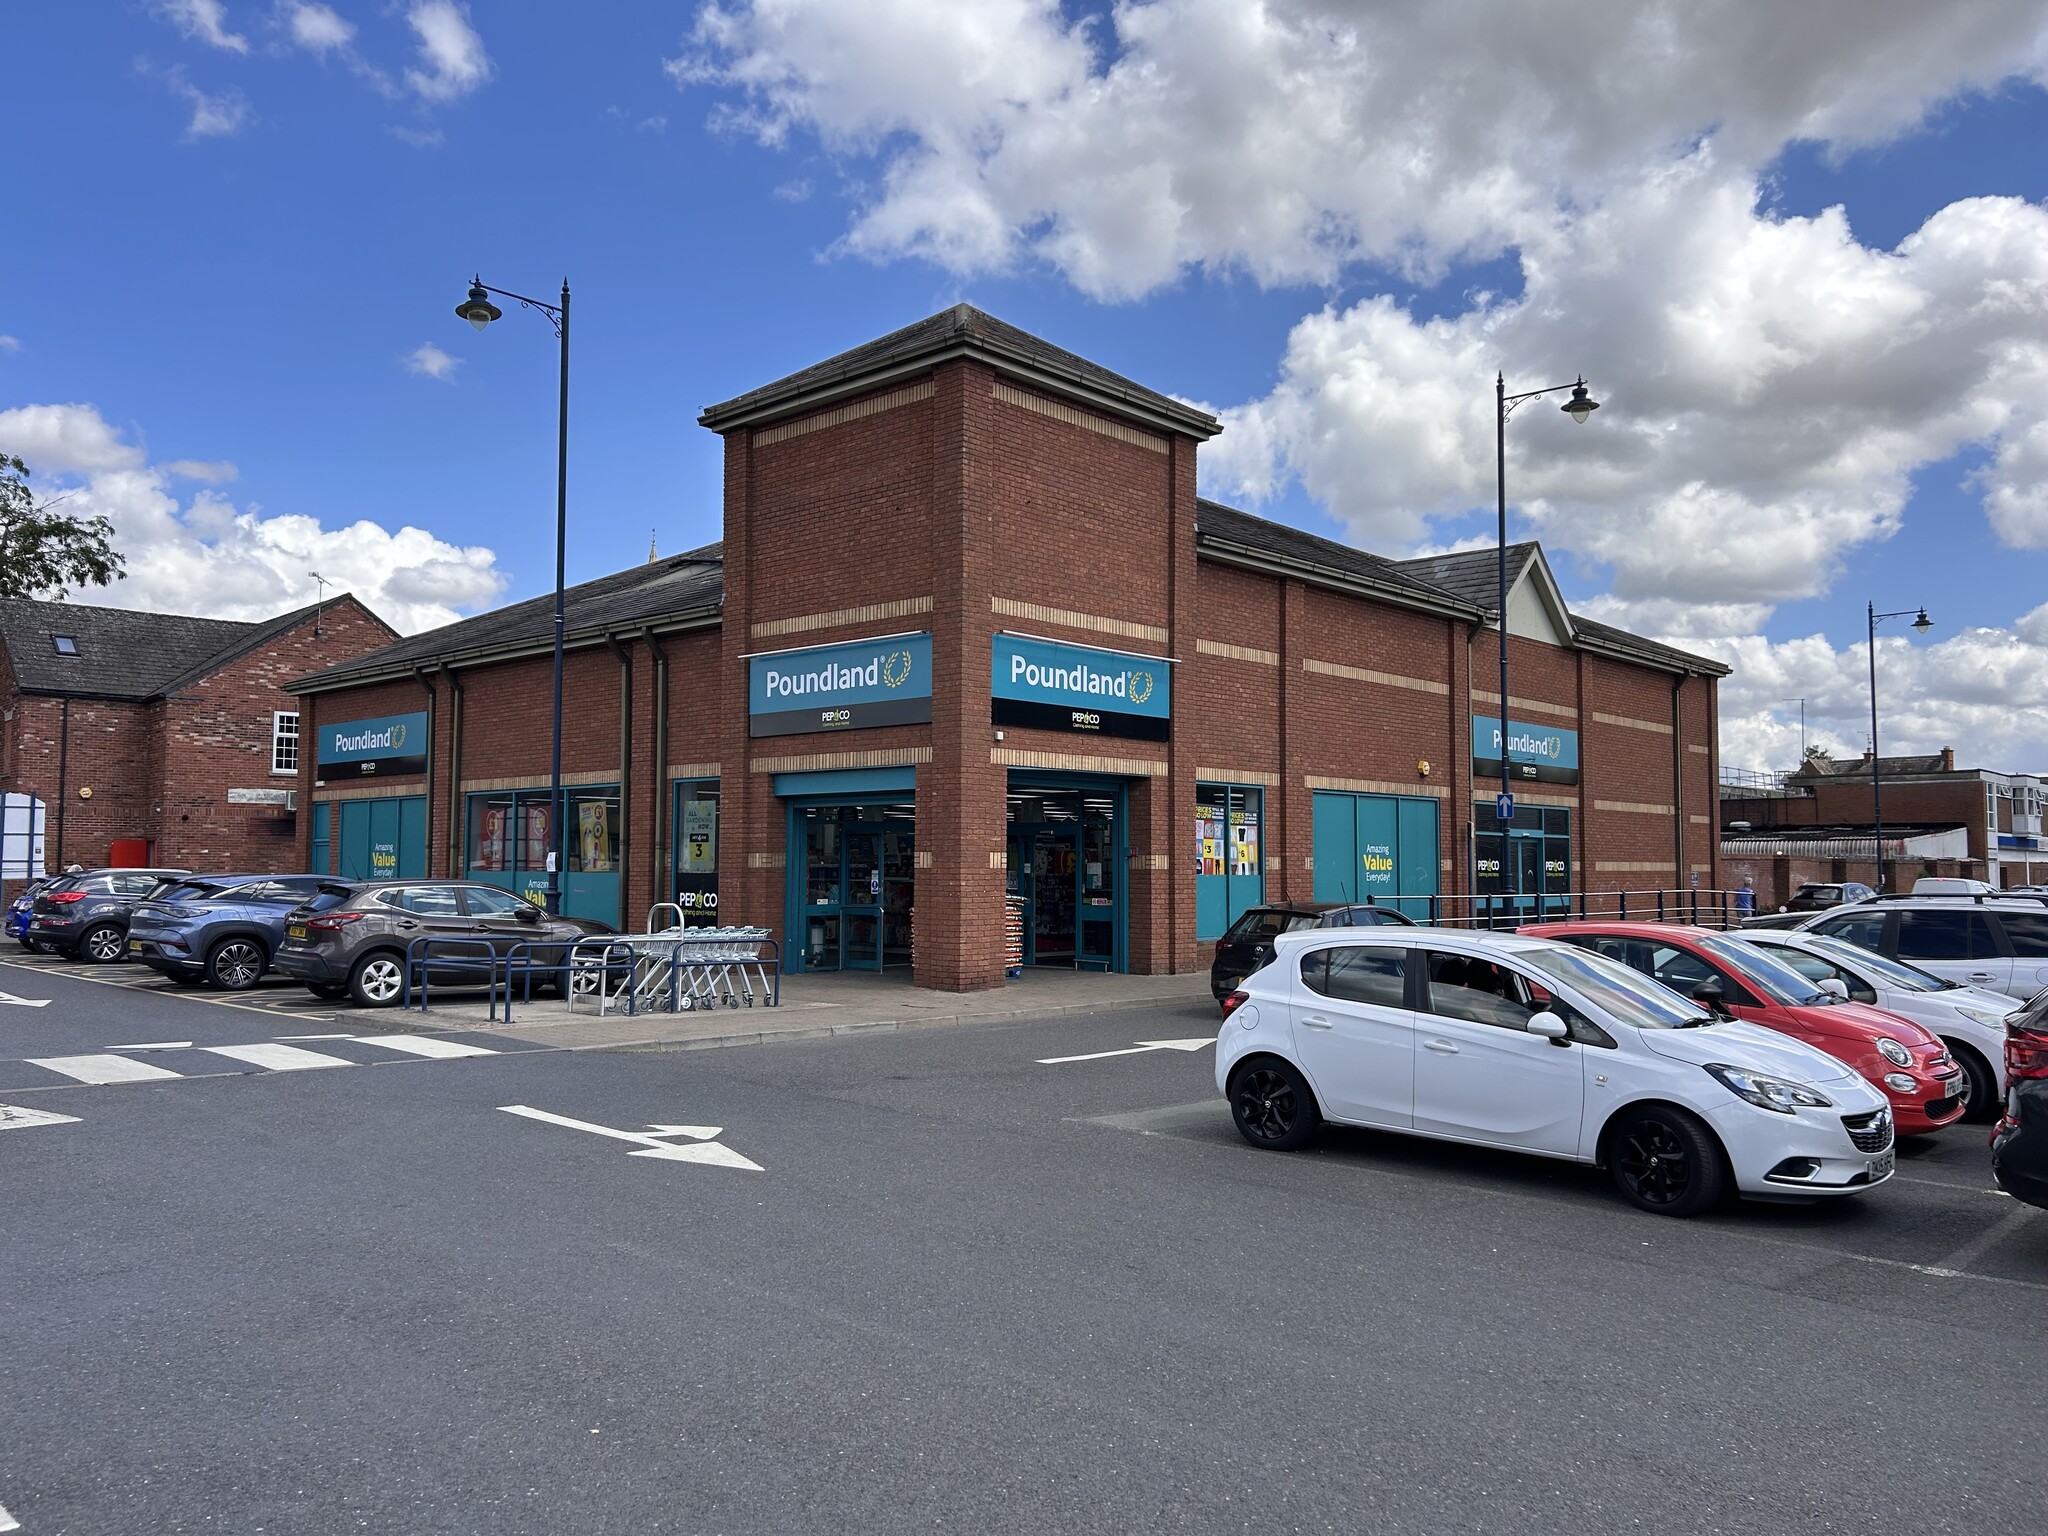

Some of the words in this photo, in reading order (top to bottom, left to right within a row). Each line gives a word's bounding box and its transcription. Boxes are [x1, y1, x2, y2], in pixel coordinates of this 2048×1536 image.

[766, 657, 878, 698] Poundland
[1011, 654, 1126, 698] Poundland
[335, 727, 391, 753] Poundland
[1493, 729, 1548, 755] Pundland
[374, 843, 394, 853] Amazing
[695, 843, 703, 858] 3
[1366, 844, 1390, 856] Amazing
[372, 852, 396, 867] Value
[1362, 854, 1393, 871] Value
[528, 879, 549, 889] Amazin
[524, 889, 547, 907] Valu
